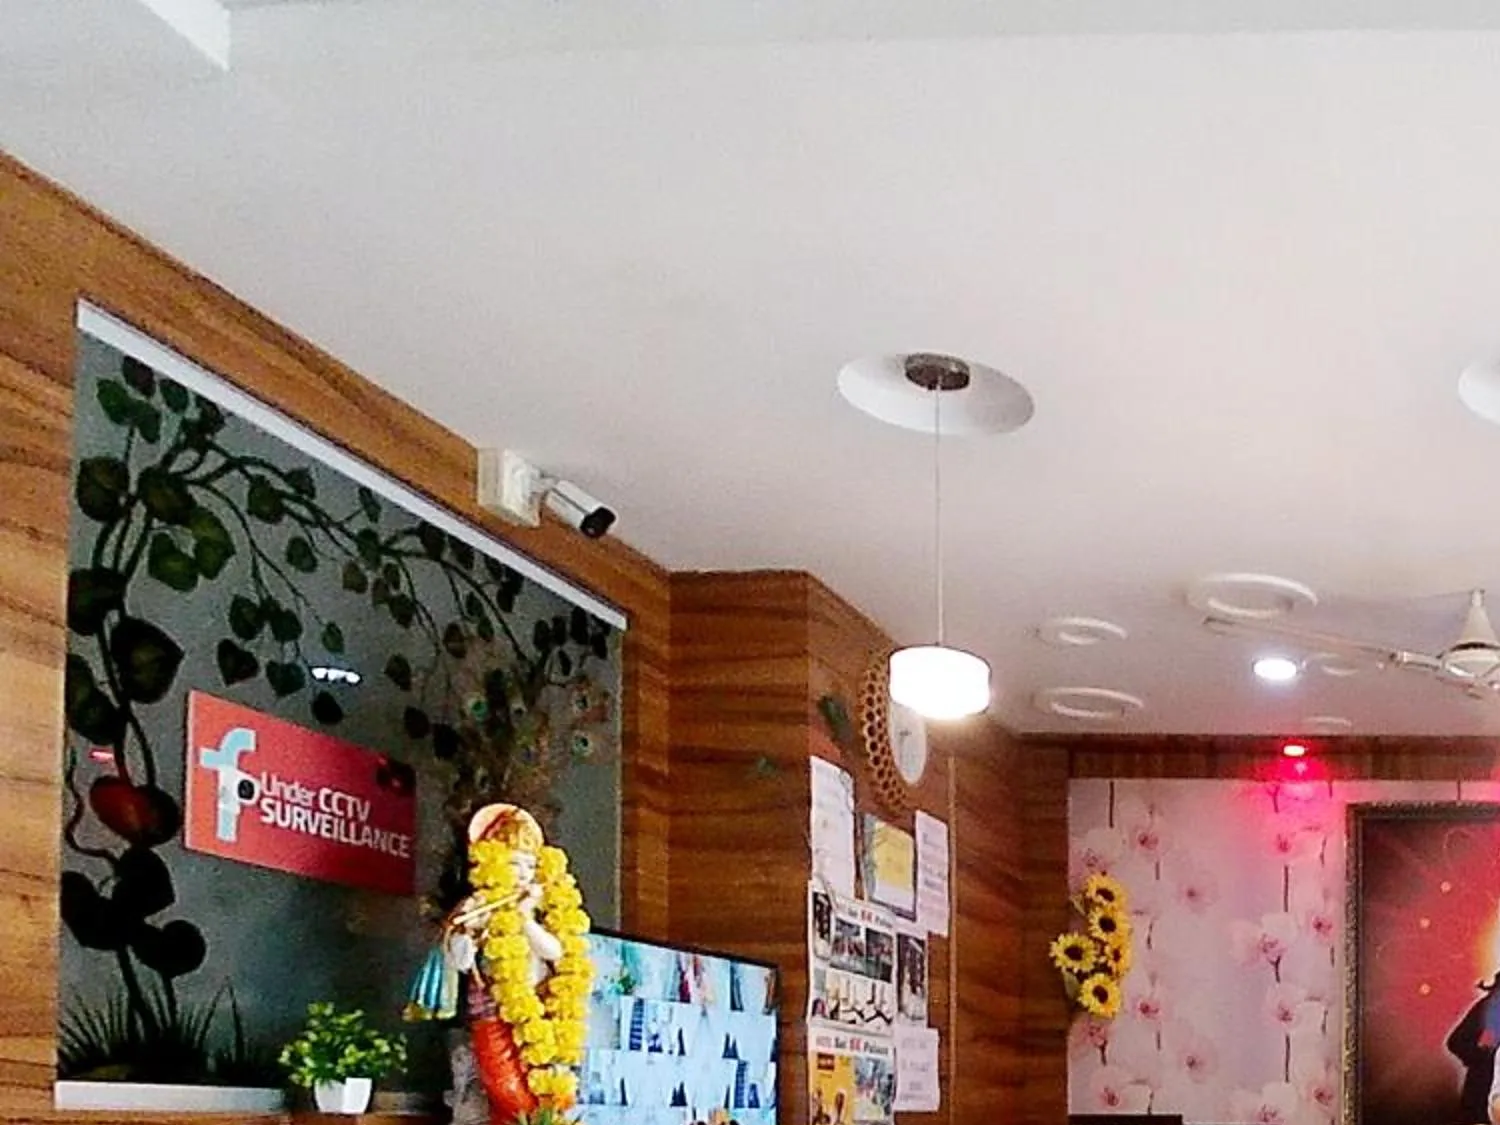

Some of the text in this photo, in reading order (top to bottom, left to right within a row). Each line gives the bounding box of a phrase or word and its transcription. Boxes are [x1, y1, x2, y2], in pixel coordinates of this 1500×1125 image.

[260, 771, 371, 822] Under CCTV
[259, 797, 411, 859] SURVEILLANCE
